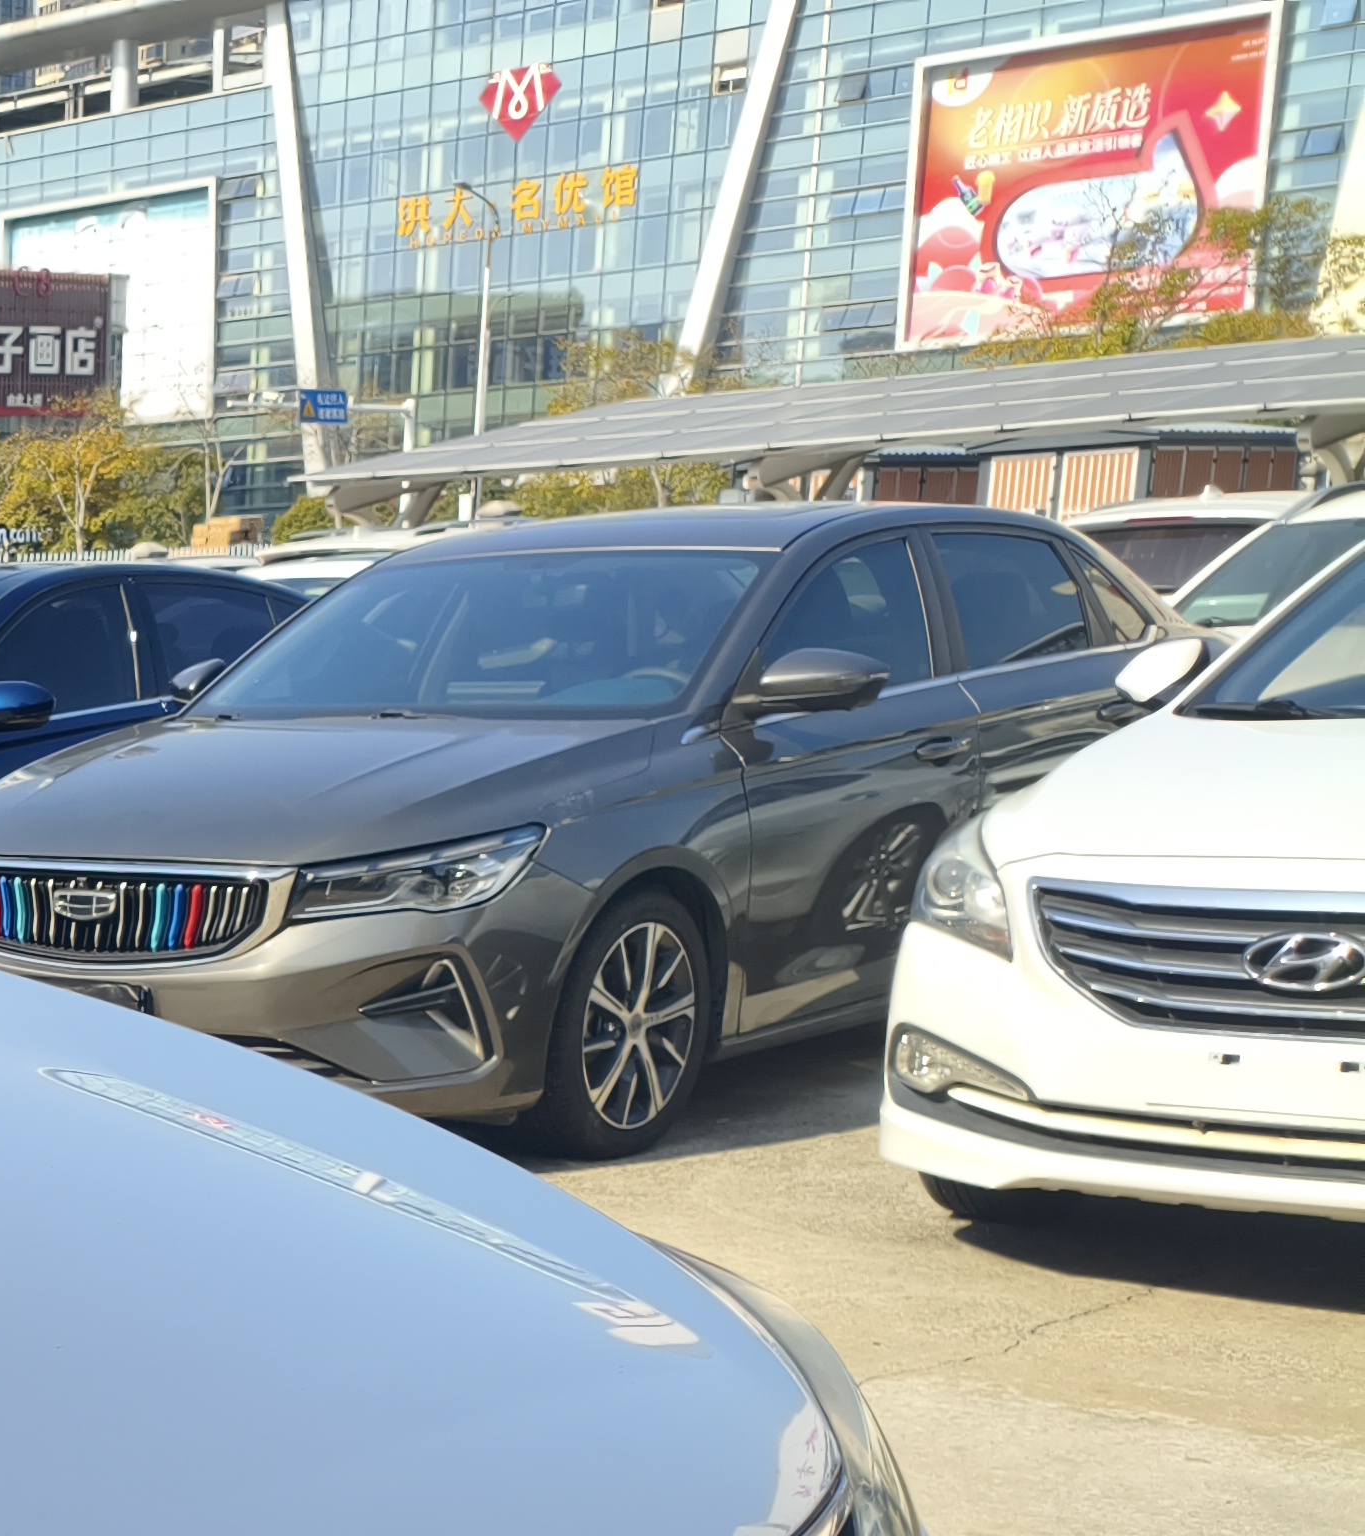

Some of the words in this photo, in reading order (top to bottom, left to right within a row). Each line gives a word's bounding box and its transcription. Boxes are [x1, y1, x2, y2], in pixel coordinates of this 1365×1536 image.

[398, 184, 474, 237] 洪大
[511, 164, 639, 221] 名优馆
